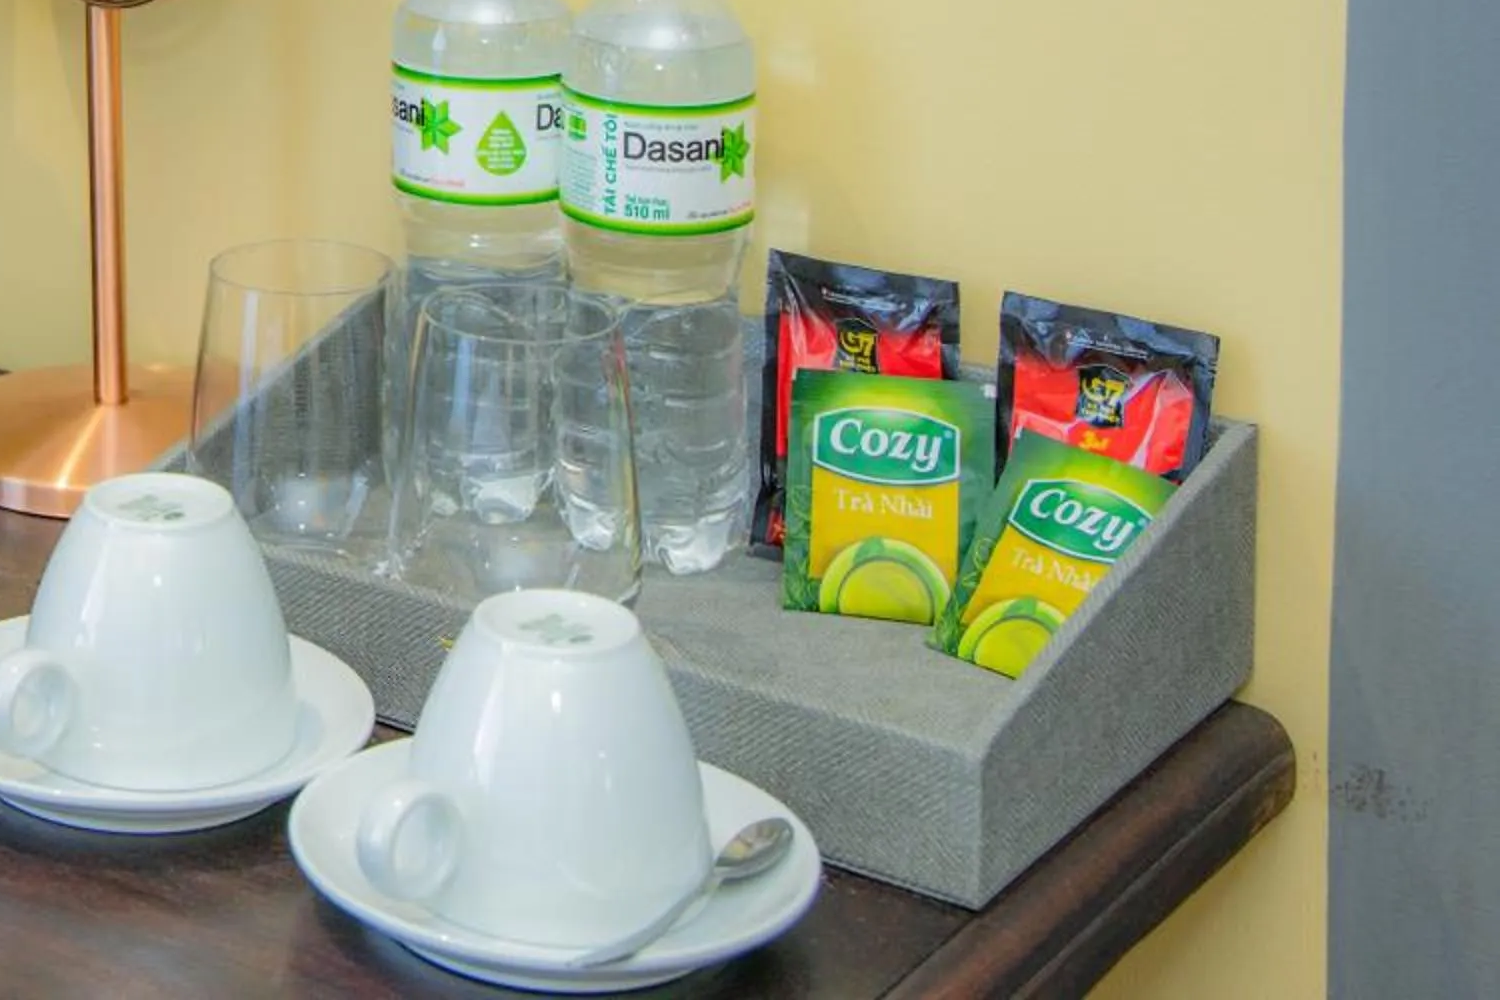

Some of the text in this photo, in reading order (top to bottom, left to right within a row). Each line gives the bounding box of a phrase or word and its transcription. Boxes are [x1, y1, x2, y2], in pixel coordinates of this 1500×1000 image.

[391, 96, 425, 127] sani
[622, 129, 726, 163] Dasani
[623, 204, 649, 219] 510
[653, 205, 671, 221] ml
[828, 417, 943, 473] Cozy
[833, 486, 934, 520] Trà Nhài
[1028, 487, 1136, 552] Cozy
[1011, 545, 1044, 576] Trà
